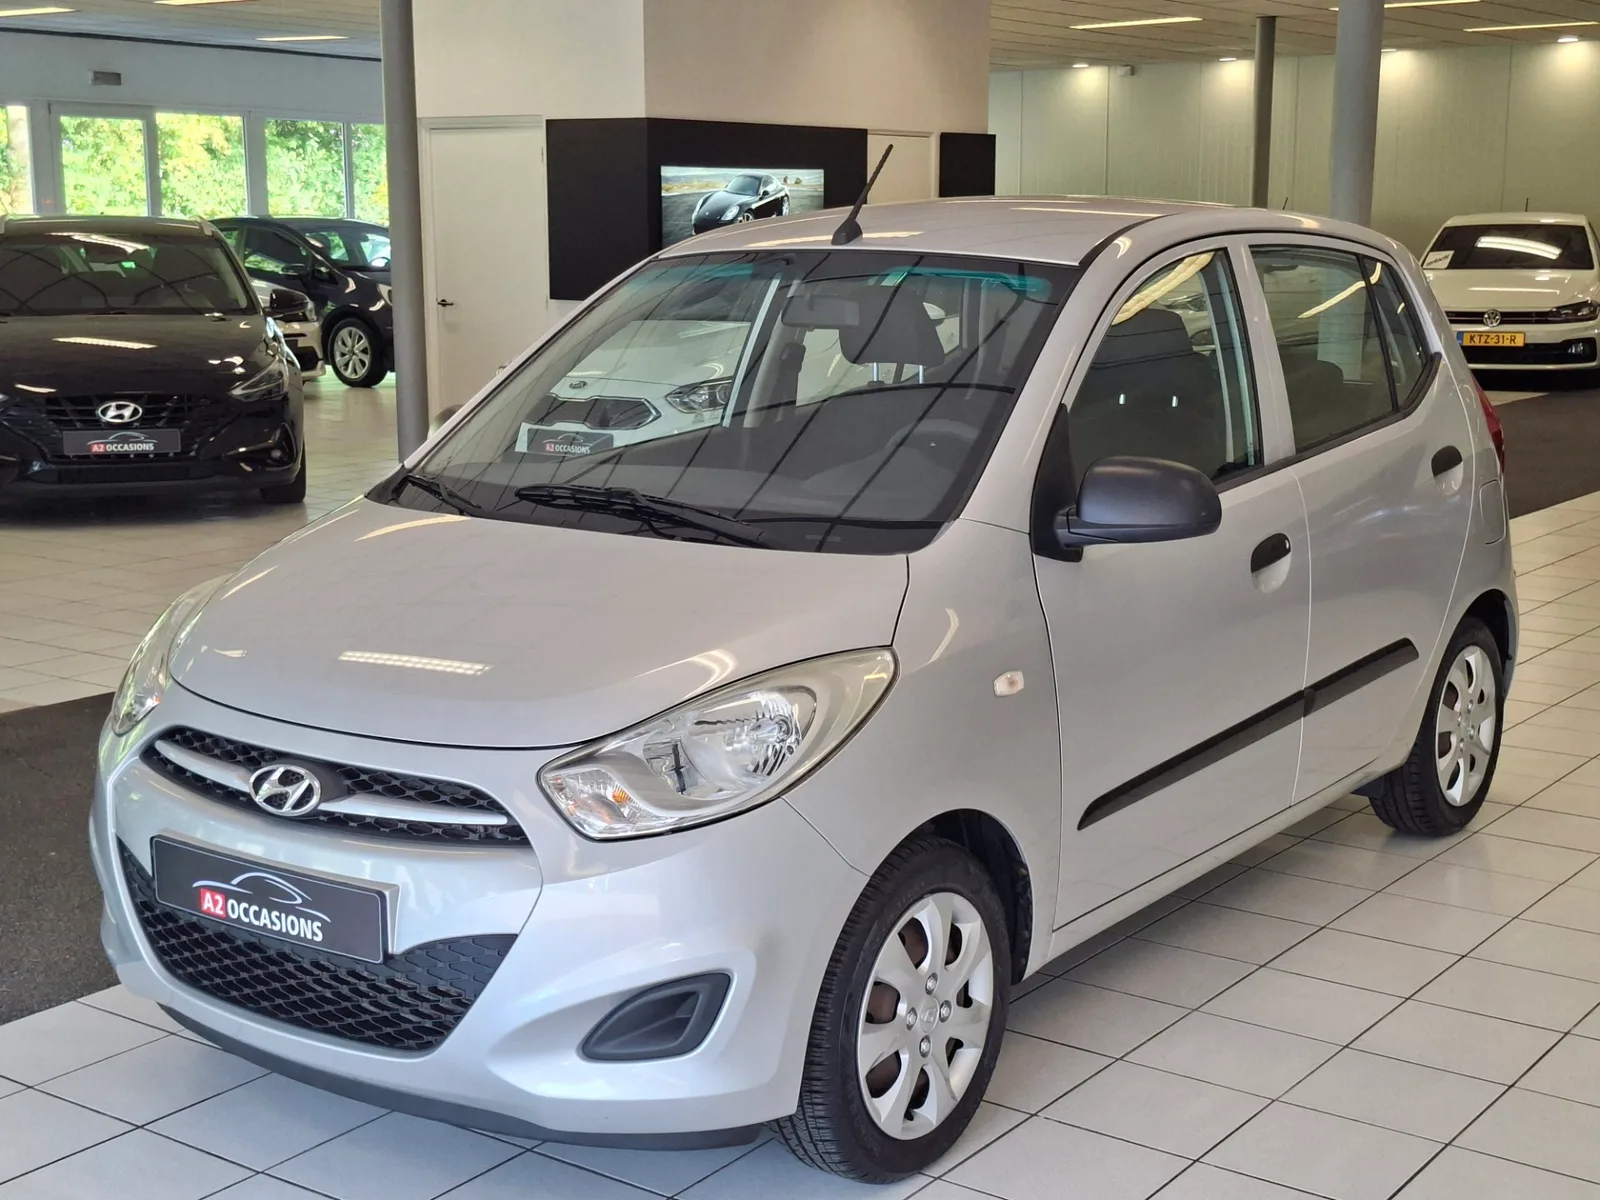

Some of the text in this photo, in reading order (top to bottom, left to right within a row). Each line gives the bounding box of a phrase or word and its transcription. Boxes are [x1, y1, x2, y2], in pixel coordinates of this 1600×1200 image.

[1469, 334, 1517, 344] KTZ-31-R
[92, 443, 155, 452] A2 OCCASIONS
[545, 443, 591, 454] A2 OCCASIONS
[203, 892, 323, 942] A2 OCCASIONS
